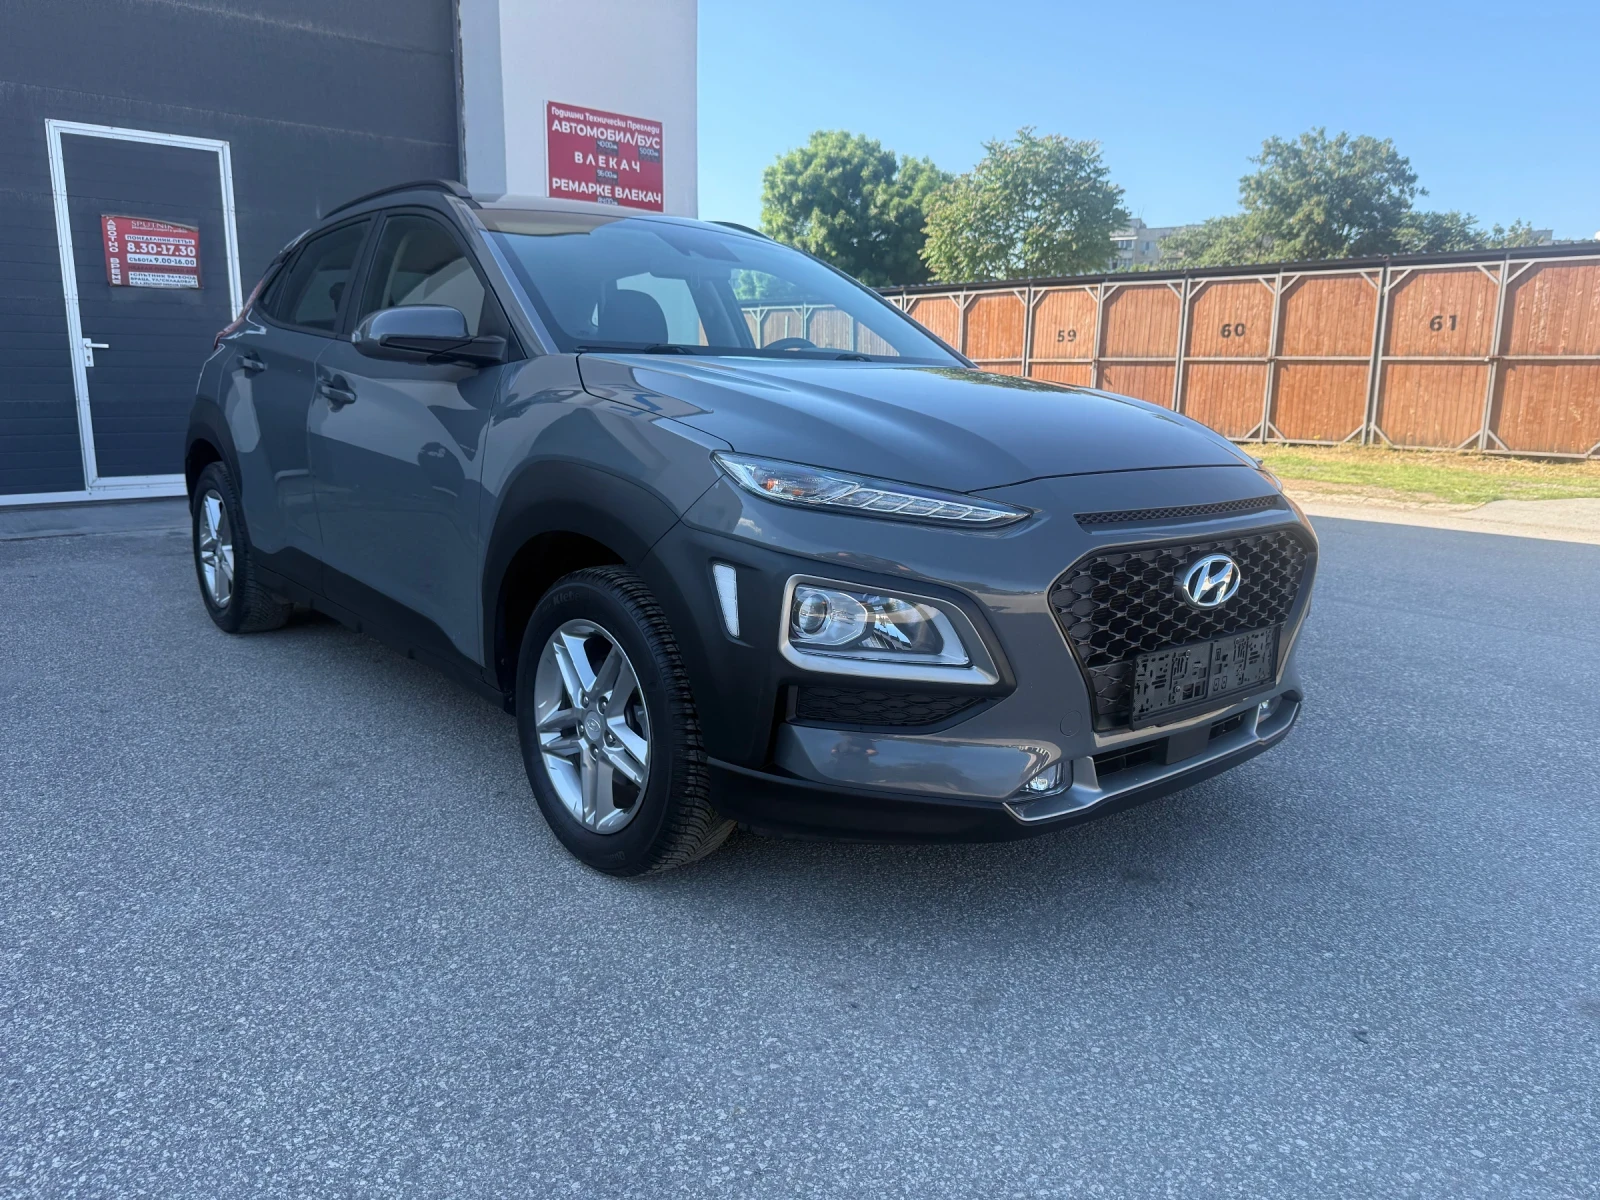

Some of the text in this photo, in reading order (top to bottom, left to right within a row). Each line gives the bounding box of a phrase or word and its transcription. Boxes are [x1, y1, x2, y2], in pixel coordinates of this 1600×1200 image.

[551, 106, 660, 135] Годишни Технически Прегледи
[551, 119, 661, 149] АВТОМОБИЛ/БУС
[552, 177, 662, 205] РЕМАРКЕ ВЛЕКАЧ
[106, 216, 122, 285] АБОТНО ВРЕМЕ
[127, 242, 196, 257] 8.30-17.30
[154, 257, 195, 267] 9.00-16.00
[1221, 323, 1246, 339] 60
[1430, 315, 1457, 331] 61
[1056, 329, 1077, 343] 59
[553, 590, 583, 606] Klebe
